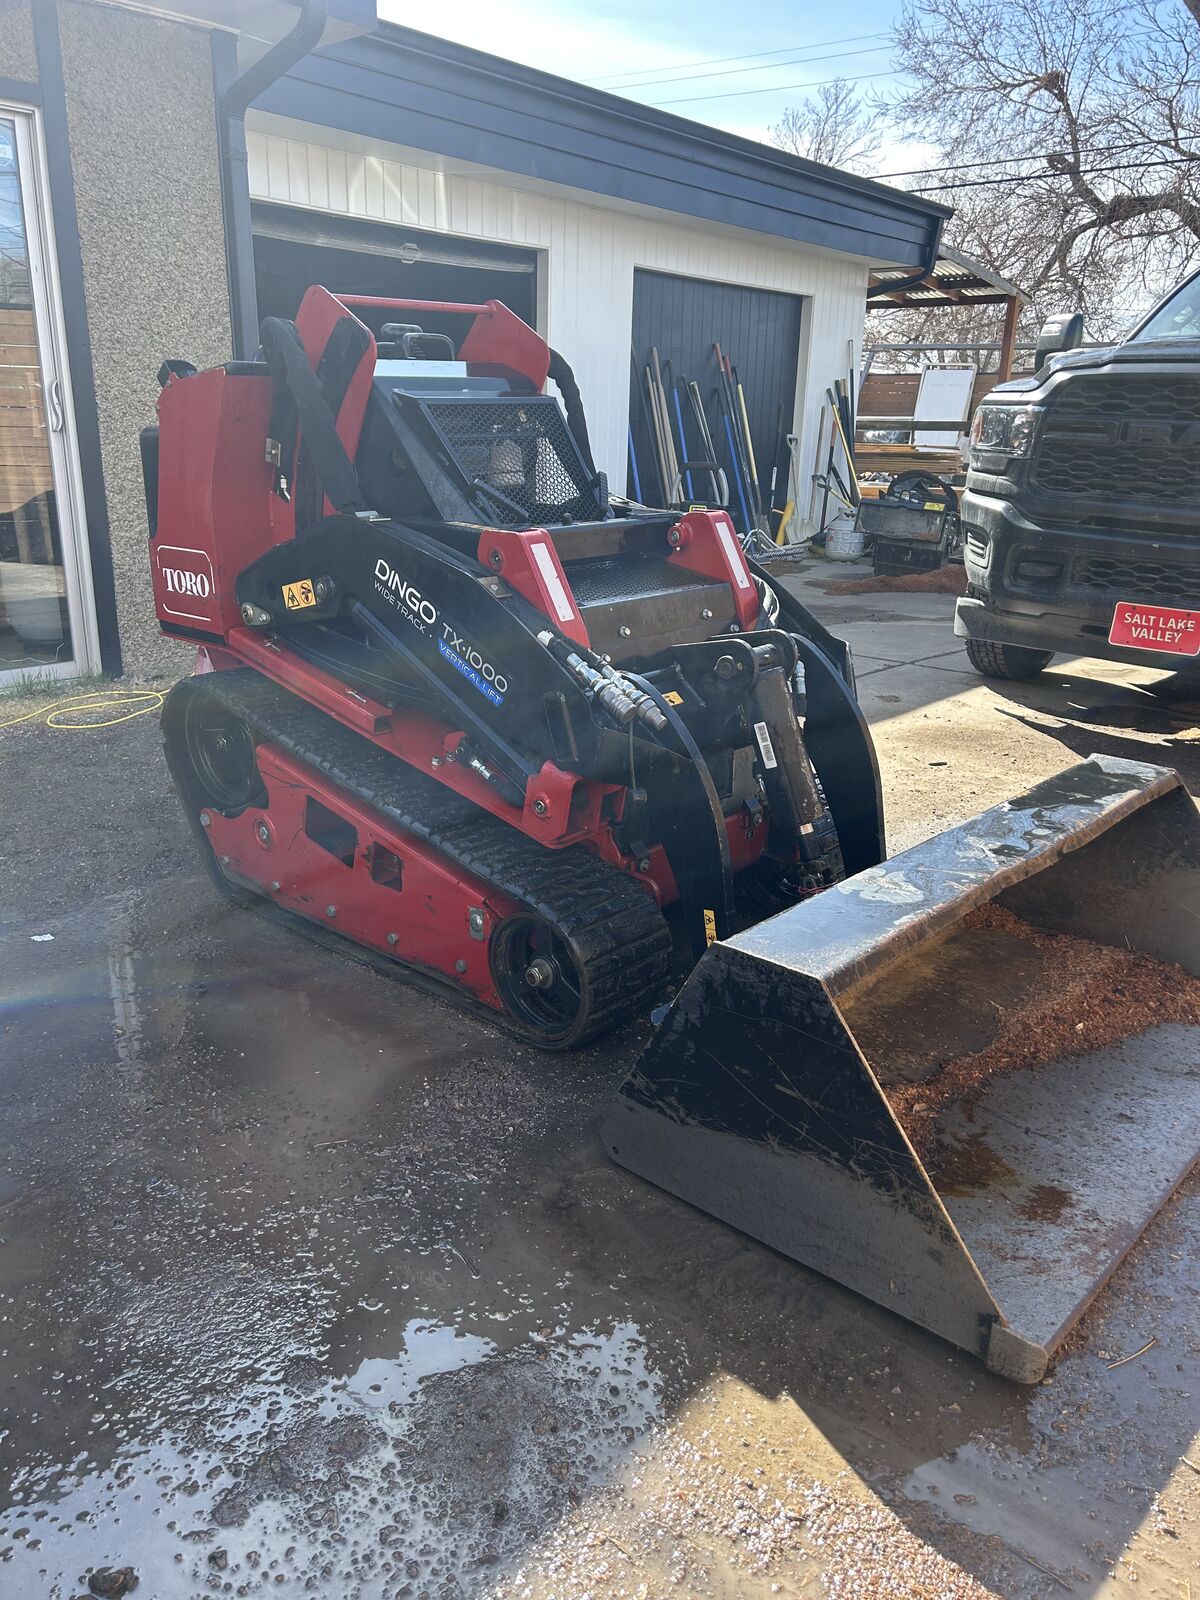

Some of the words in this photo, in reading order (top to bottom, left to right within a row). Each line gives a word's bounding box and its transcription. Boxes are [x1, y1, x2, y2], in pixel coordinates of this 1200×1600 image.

[163, 567, 210, 598] TORO
[374, 559, 436, 624] DINGO
[374, 580, 396, 605] WIDE
[396, 600, 427, 634] TRACK
[1124, 612, 1157, 626] SALT
[1159, 617, 1196, 632] LAKE
[1131, 627, 1183, 643] VALLEY
[440, 642, 481, 687] VERTICAL
[482, 683, 501, 703] LIFT
